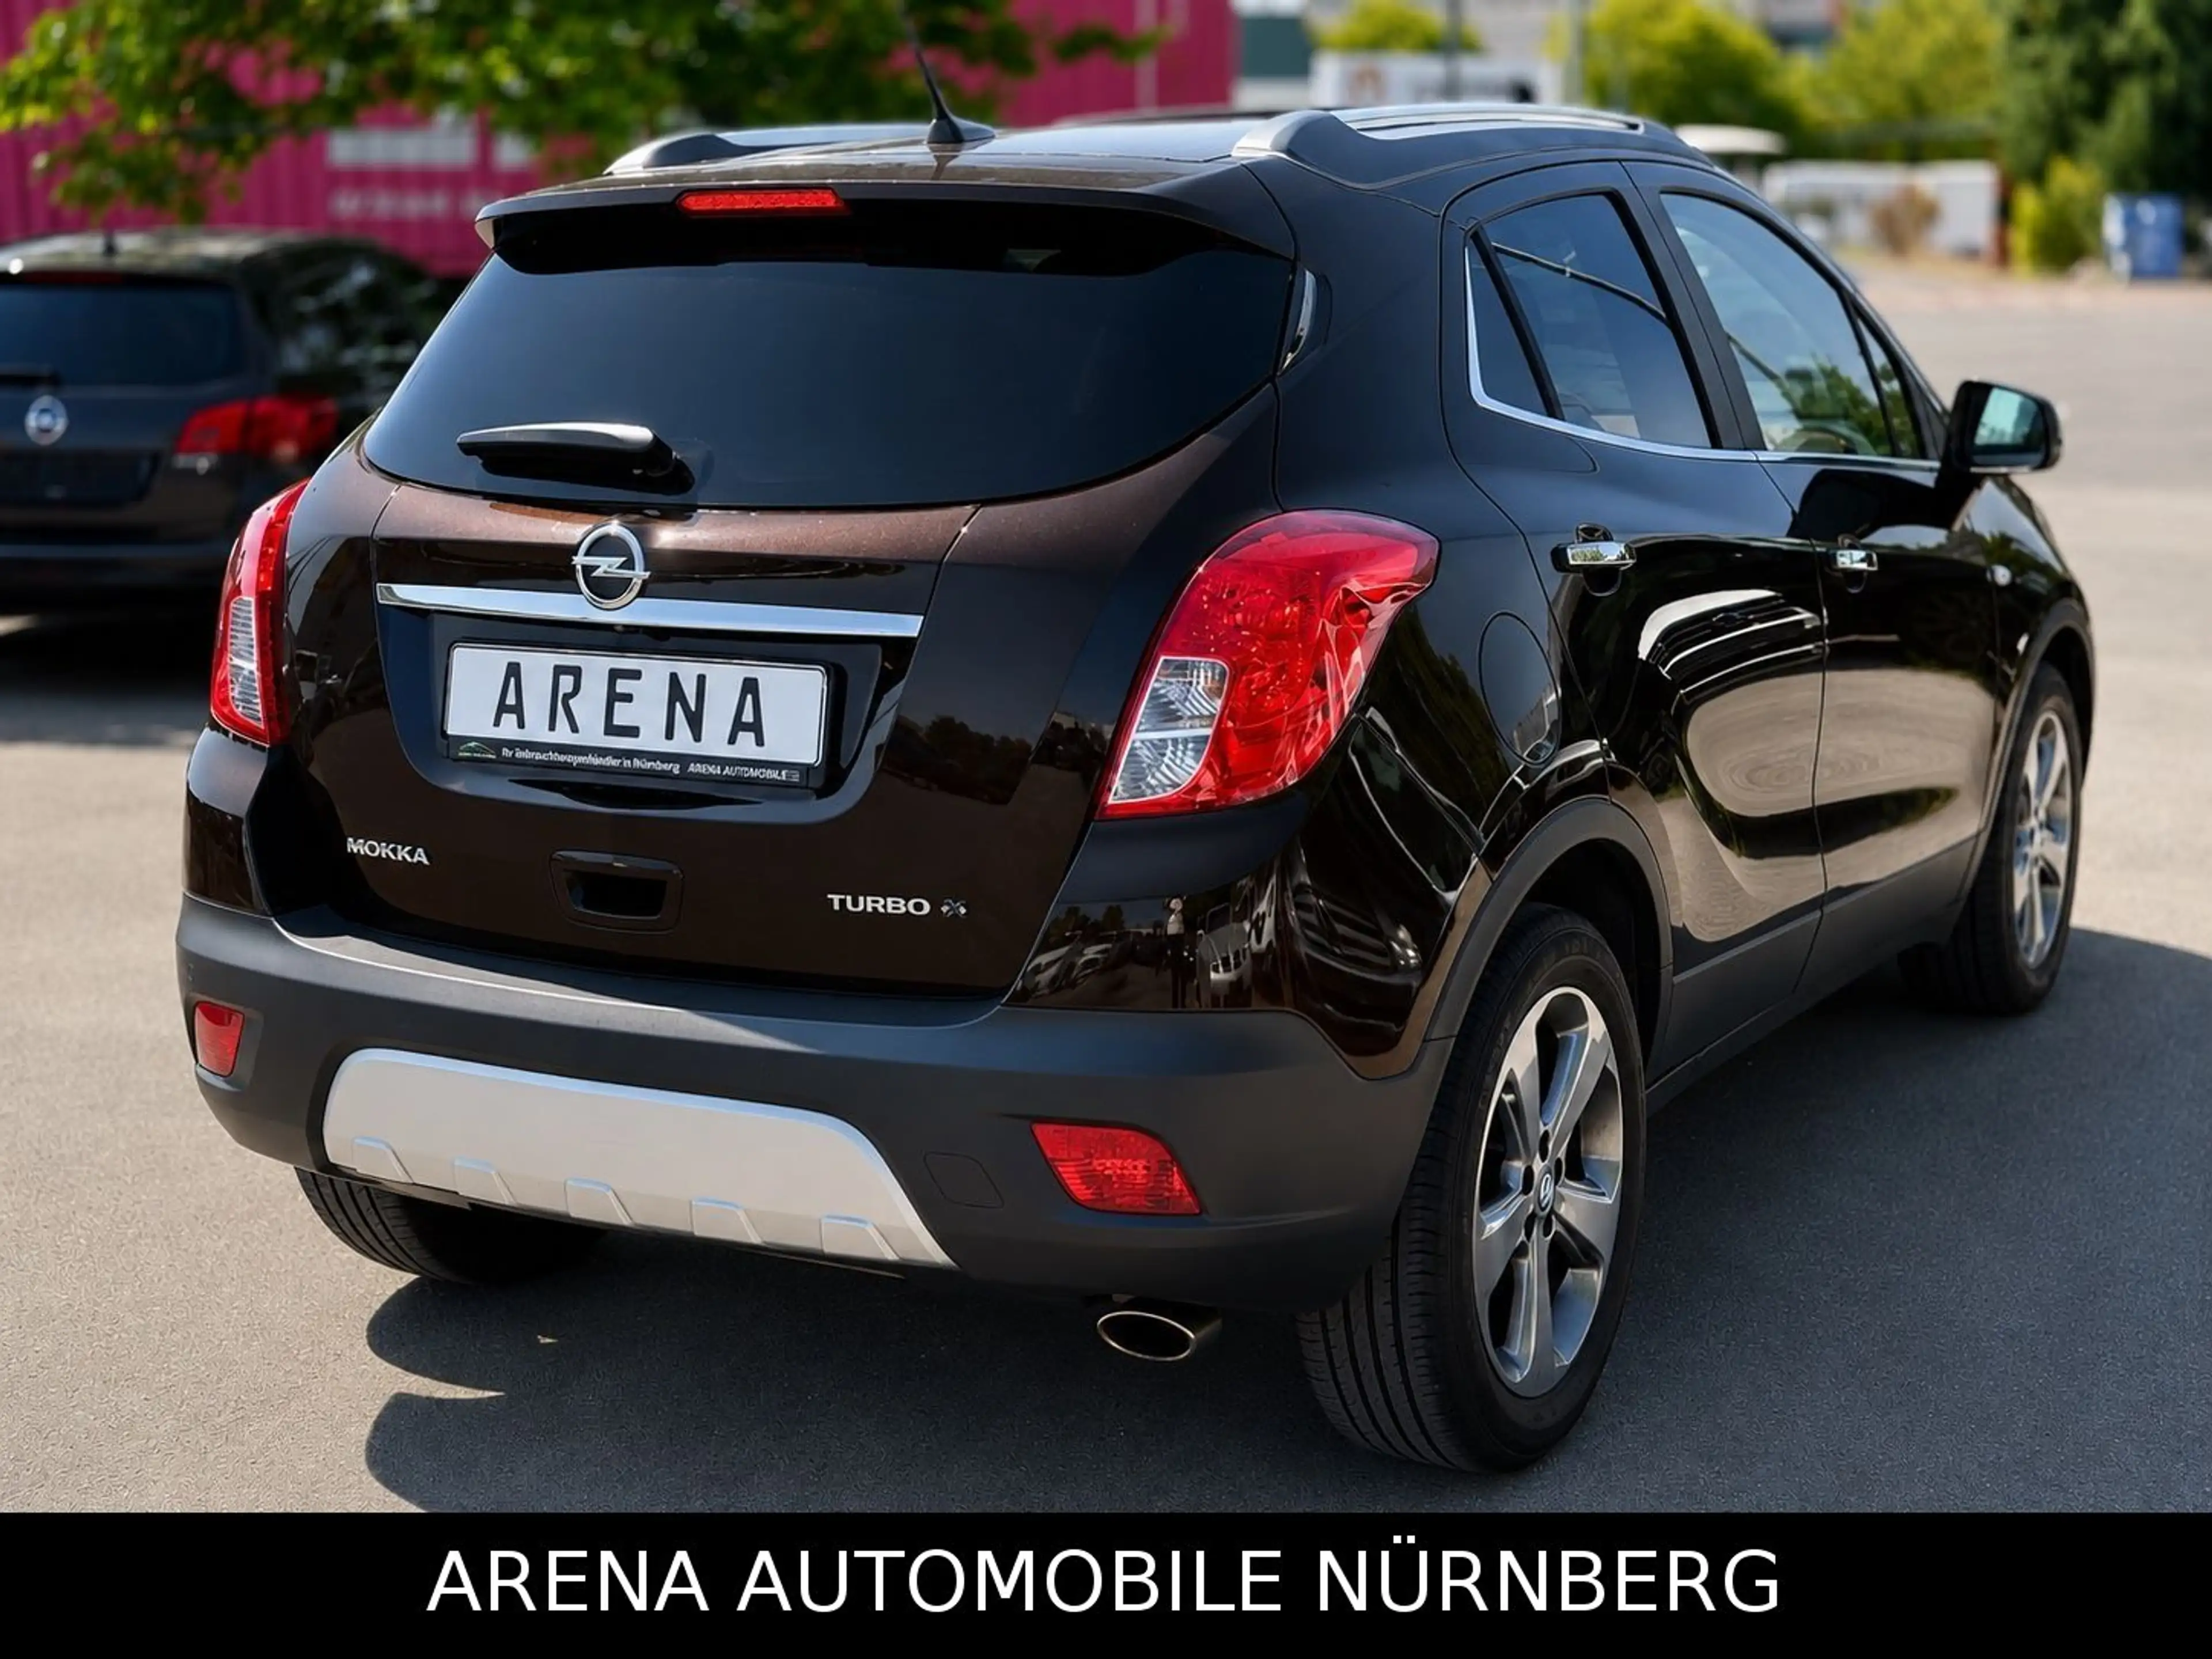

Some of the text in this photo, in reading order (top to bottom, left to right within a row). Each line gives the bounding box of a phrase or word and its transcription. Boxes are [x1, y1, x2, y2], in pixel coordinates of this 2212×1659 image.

[493, 662, 765, 747] ARENA
[347, 837, 430, 865] MOKKA
[827, 894, 931, 915] TURBO
